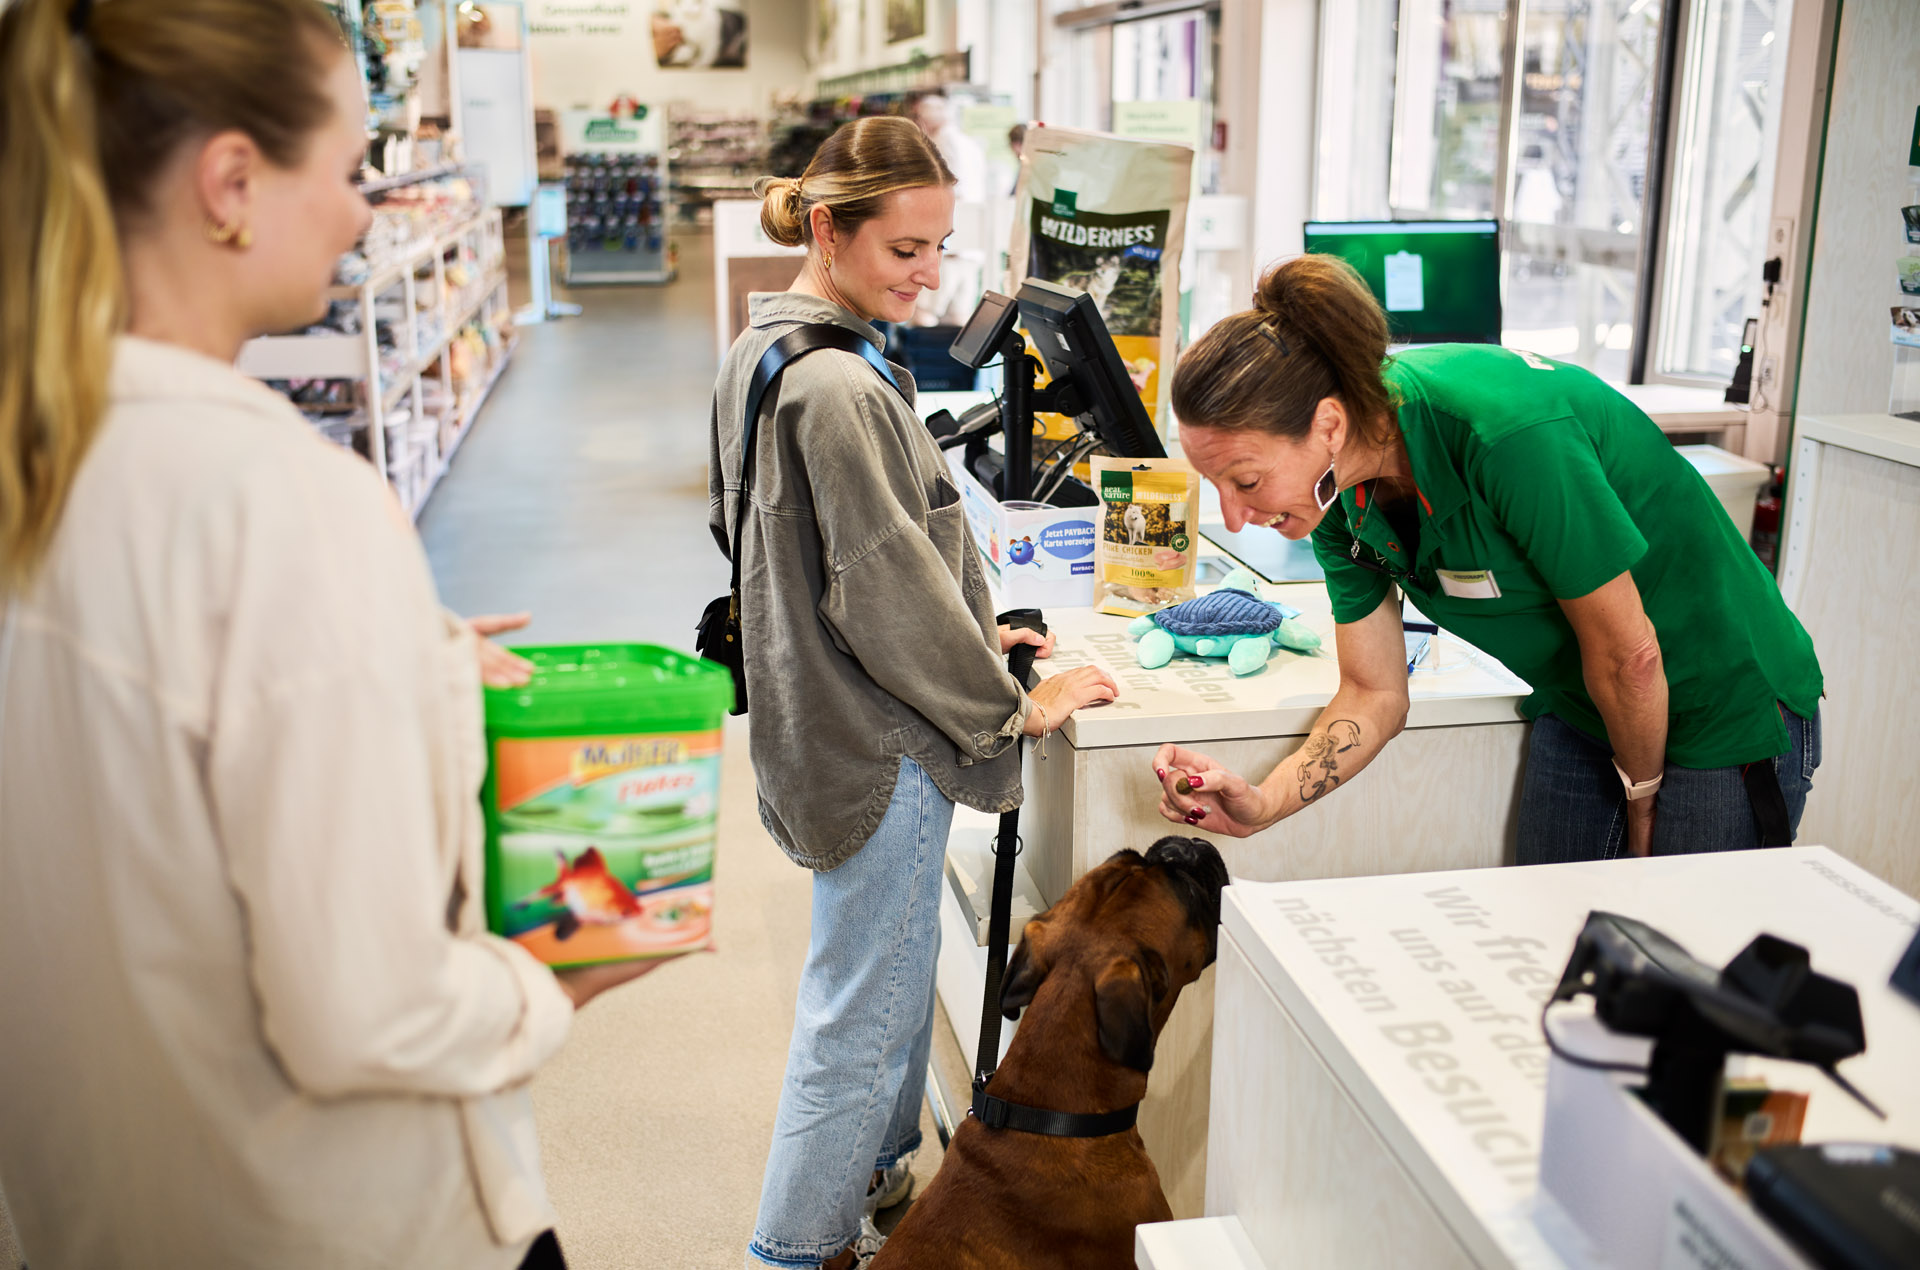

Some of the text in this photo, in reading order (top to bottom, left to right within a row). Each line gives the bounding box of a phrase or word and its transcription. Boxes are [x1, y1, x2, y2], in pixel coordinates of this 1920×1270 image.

[1041, 216, 1156, 248] WILDERNESS
[1135, 491, 1182, 502] WILDERNESS
[1045, 527, 1095, 539] Jetzt PAYBACK
[1044, 540, 1063, 548] Karte
[1102, 542, 1153, 556] PURE CHICKEN
[1131, 569, 1155, 578] 100%
[1422, 886, 1492, 929] Wir
[1272, 897, 1399, 1014] nächsten
[1388, 928, 1457, 974] uns
[1435, 979, 1530, 1024] auf
